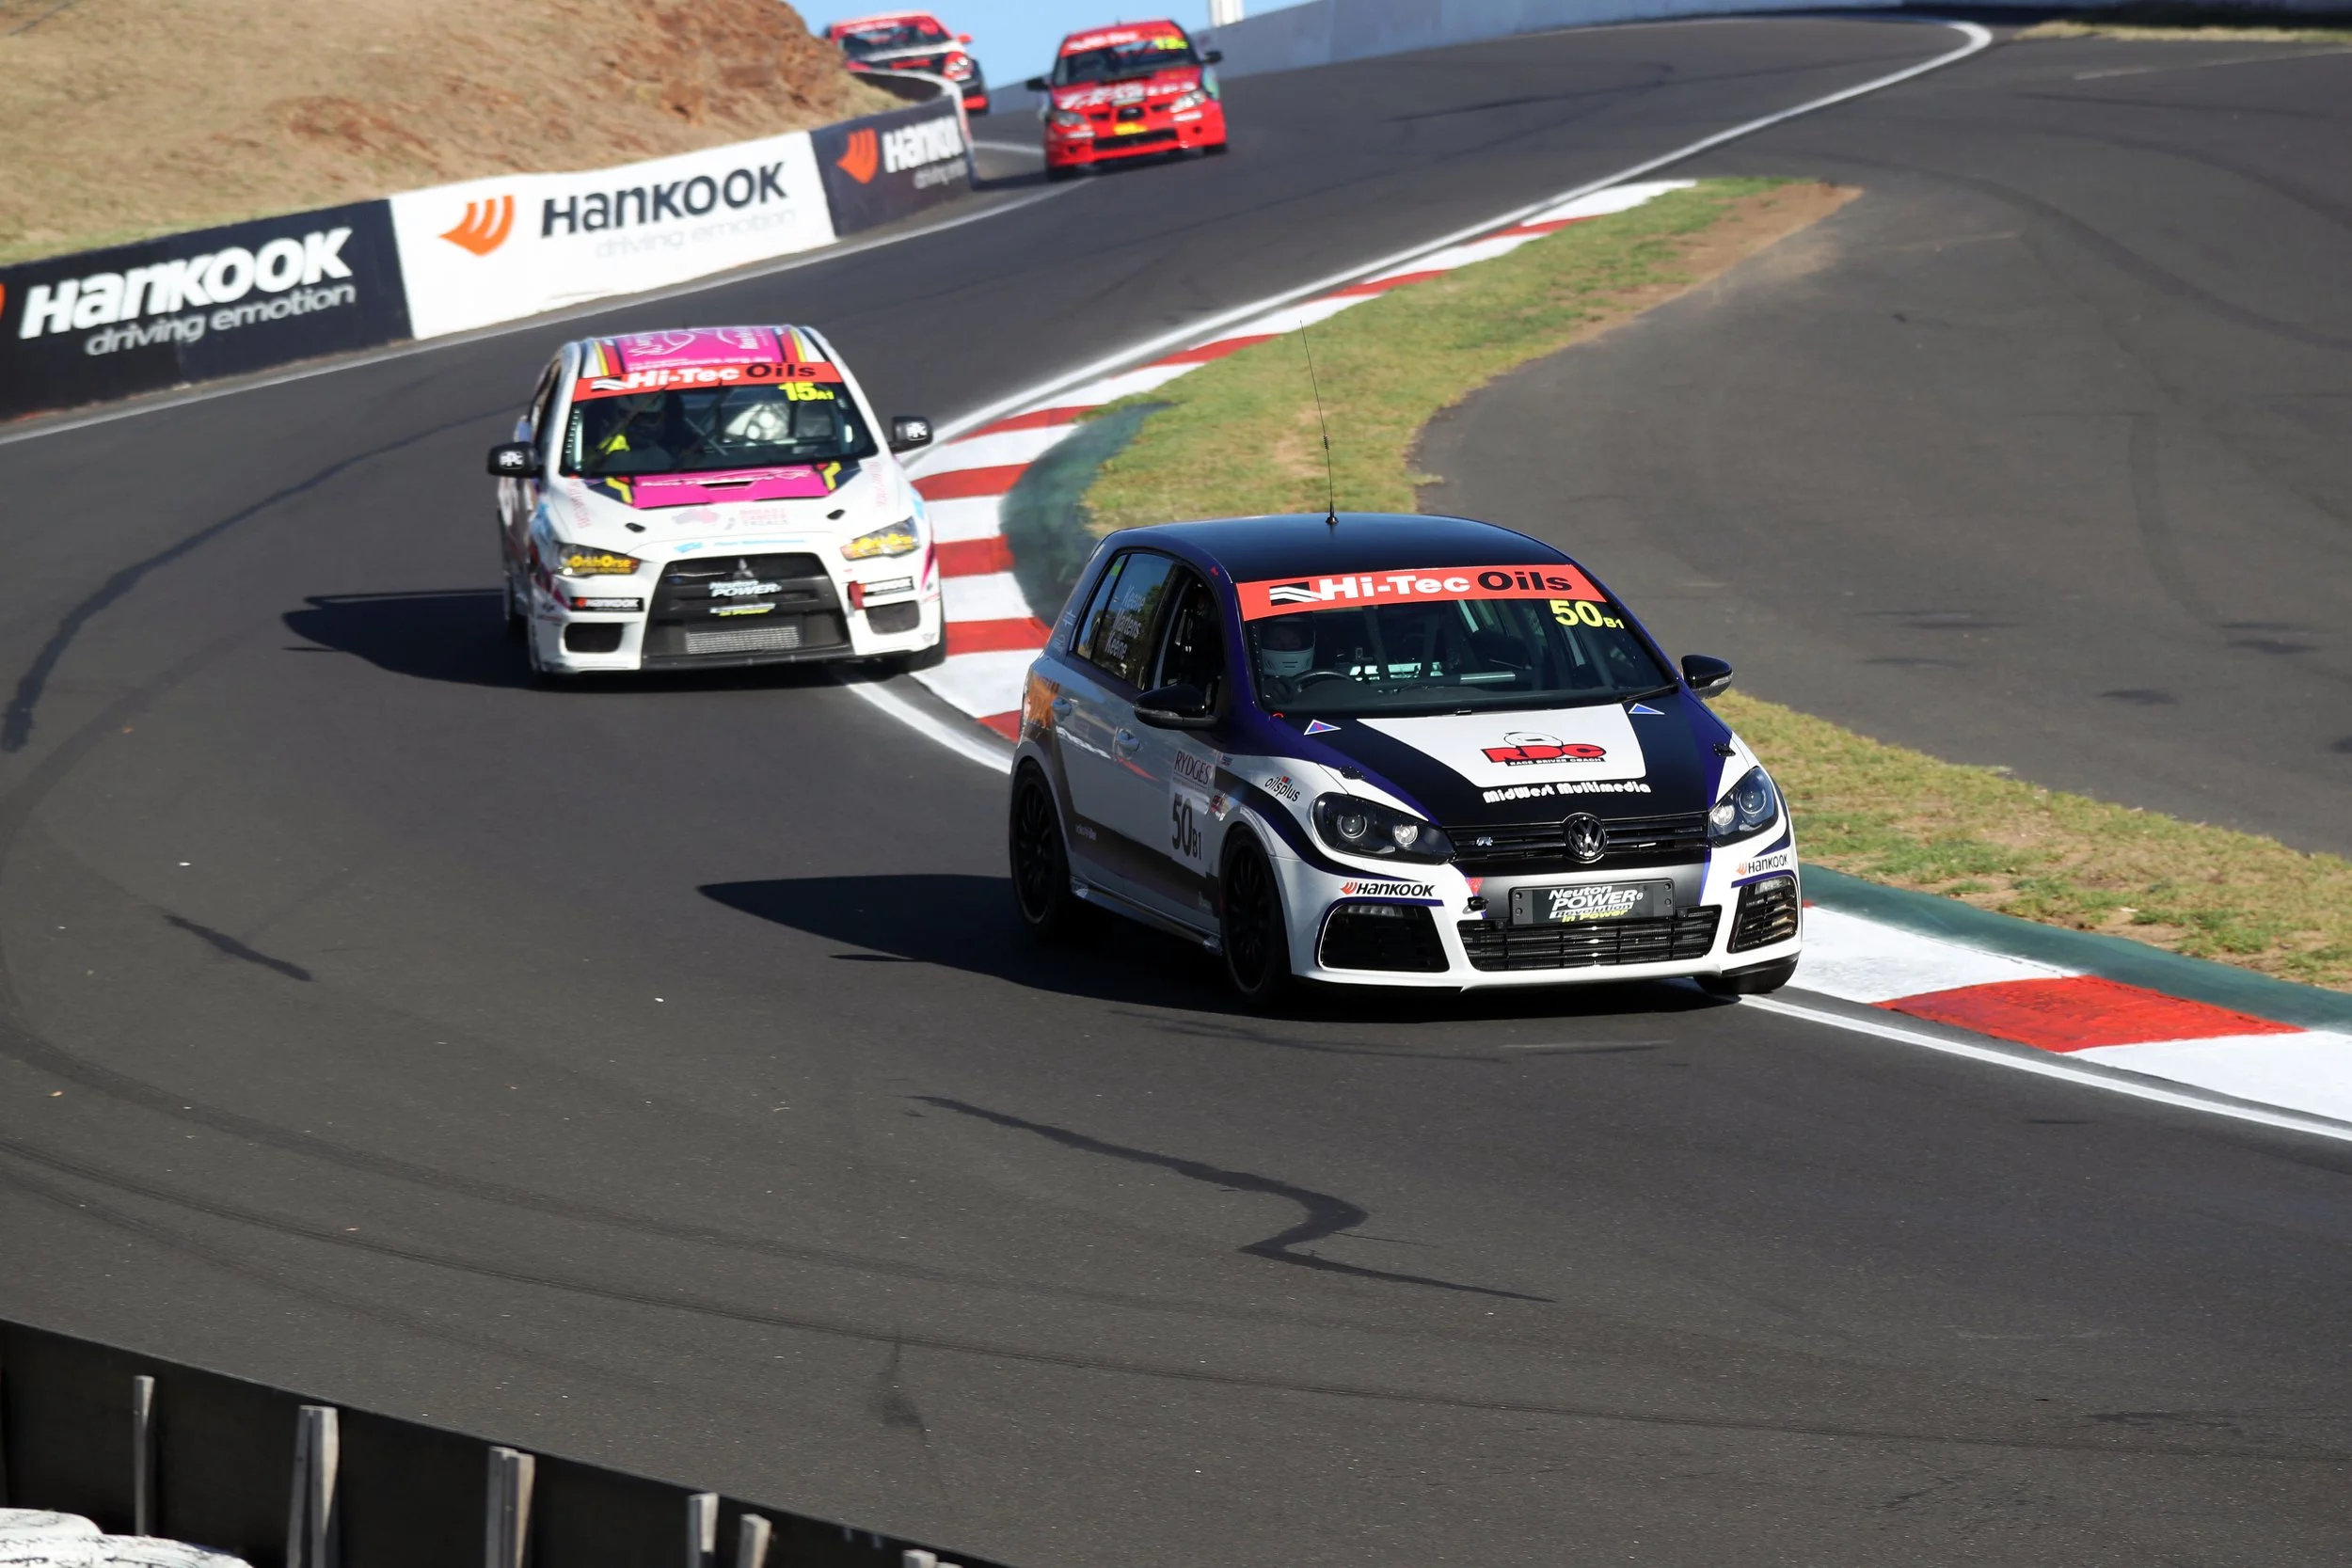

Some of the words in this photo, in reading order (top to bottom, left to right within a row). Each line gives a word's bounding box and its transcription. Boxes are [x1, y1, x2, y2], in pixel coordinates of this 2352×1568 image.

[595, 230, 685, 259] driving
[690, 208, 797, 243] emotion
[85, 313, 206, 356] driving
[210, 283, 357, 331] emotion
[628, 367, 740, 388] Hi-Tec
[745, 362, 817, 378] Oils
[1318, 574, 1470, 602] Hi-Tec
[1477, 570, 1573, 592] Oils
[1104, 630, 1129, 661] Keene
[1481, 743, 1607, 764] RDC
[1174, 750, 1213, 785] RYDGES
[1264, 776, 1301, 802] oilsplus
[1483, 784, 1555, 803] MidWest
[1556, 781, 1652, 795] Multimedia
[1549, 885, 1613, 900] Neuton
[1579, 909, 1629, 921] Power
